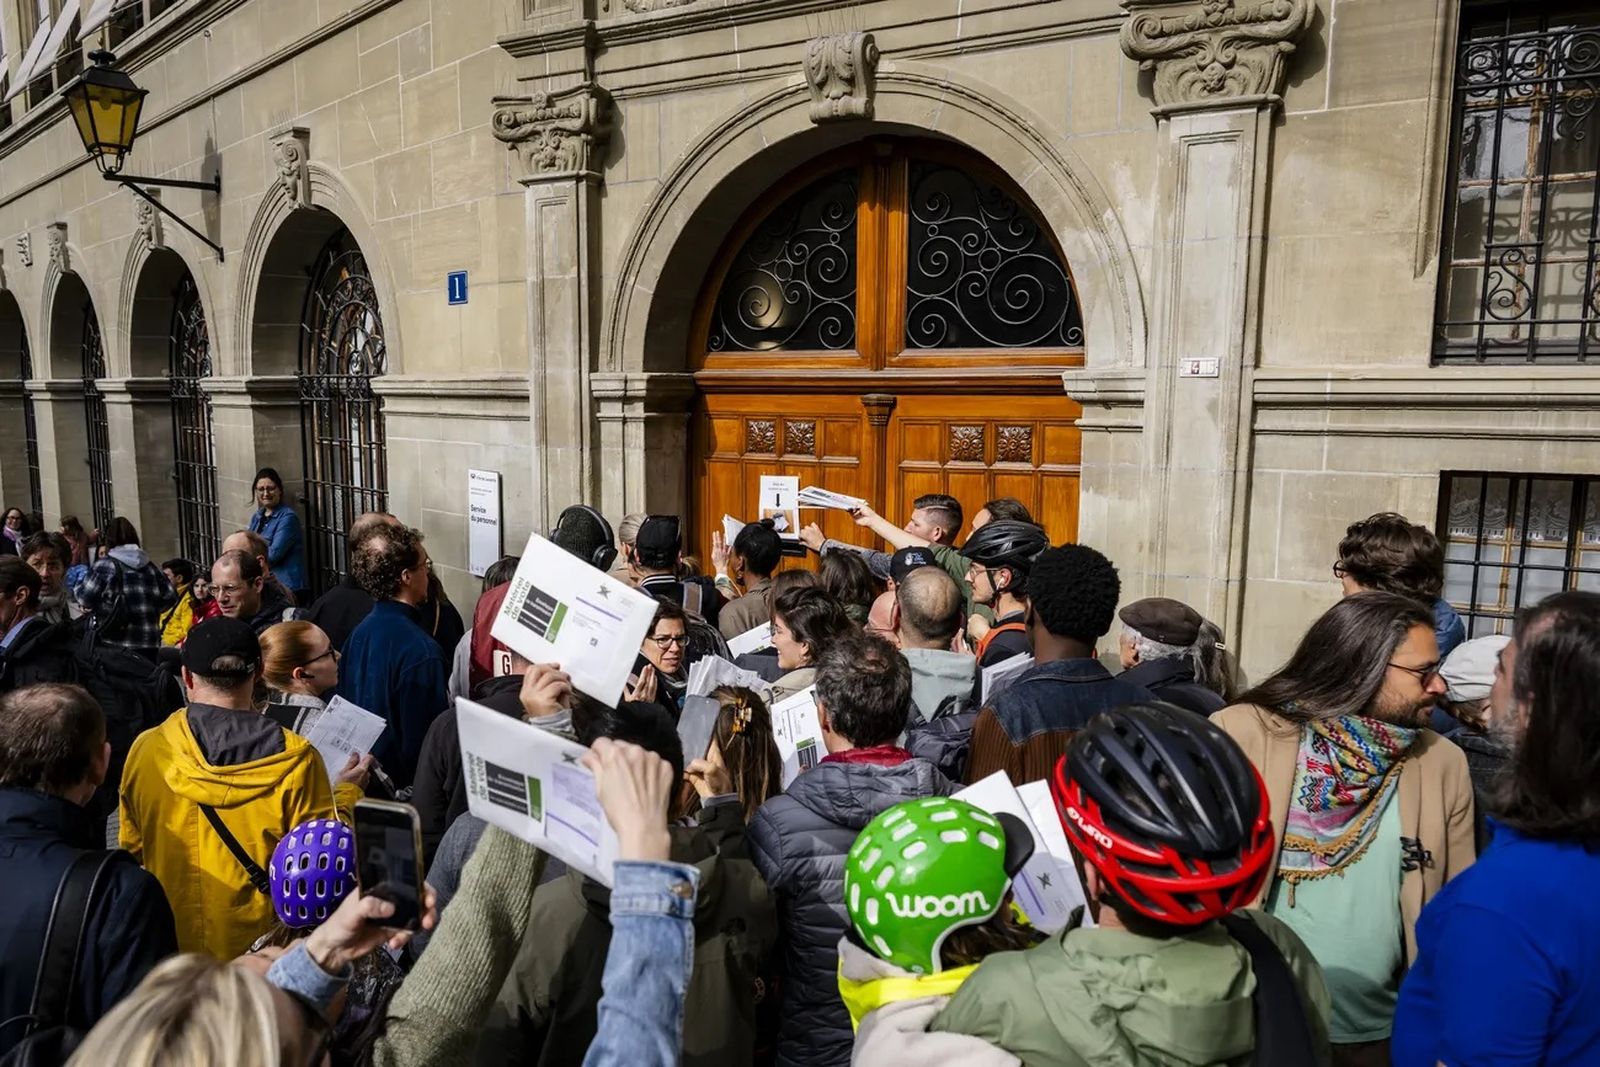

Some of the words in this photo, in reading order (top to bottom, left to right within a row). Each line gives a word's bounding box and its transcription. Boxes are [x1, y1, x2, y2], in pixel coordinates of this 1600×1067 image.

[454, 277, 461, 299] 1
[471, 504, 487, 514] Service
[471, 514, 477, 522] du
[476, 516, 498, 527] personnel
[504, 576, 525, 616] Matériel
[511, 605, 520, 620] de
[517, 580, 531, 604] vote
[502, 654, 511, 676] G
[884, 890, 991, 918] woom
